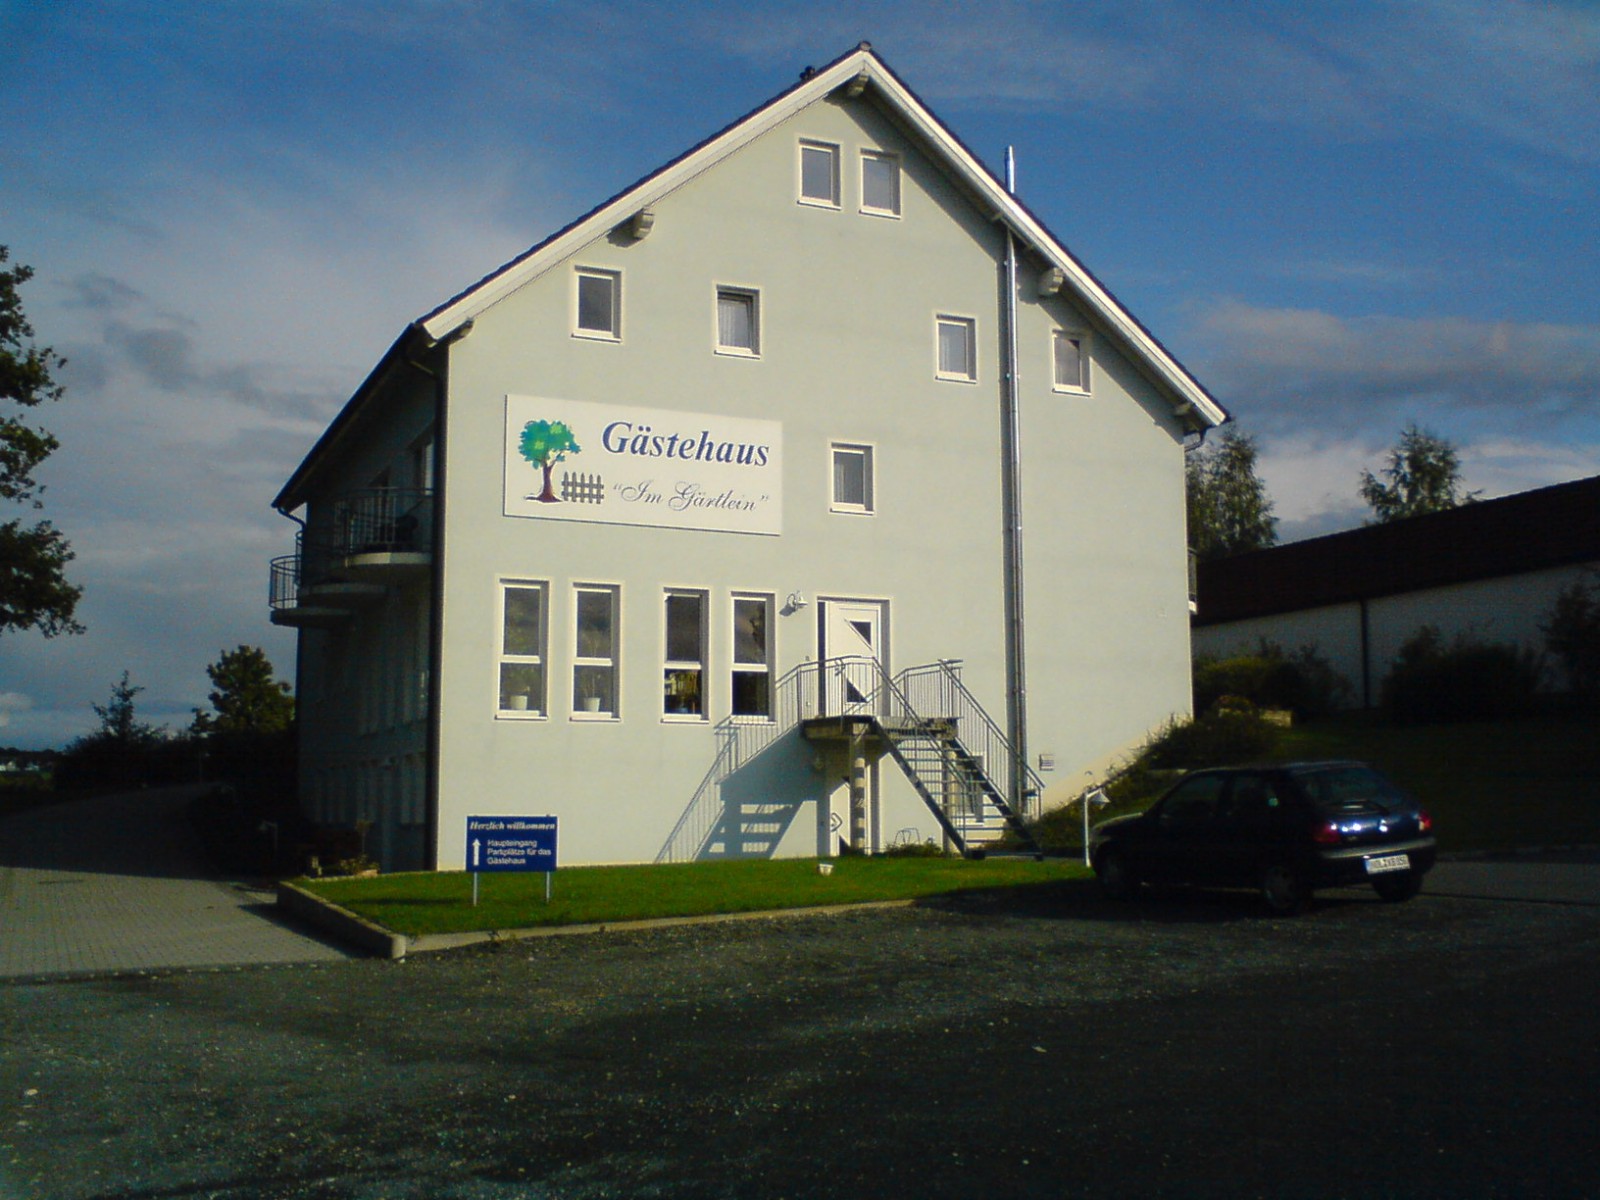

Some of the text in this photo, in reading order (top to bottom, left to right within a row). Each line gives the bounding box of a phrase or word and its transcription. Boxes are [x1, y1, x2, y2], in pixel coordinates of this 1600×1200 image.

[602, 420, 770, 467] Gästehaus
[469, 821, 556, 831] Herzlich willkommen
[487, 840, 538, 848] Haupteingang
[487, 848, 552, 857] Parkplätze für das
[487, 857, 527, 865] Gästehaus
